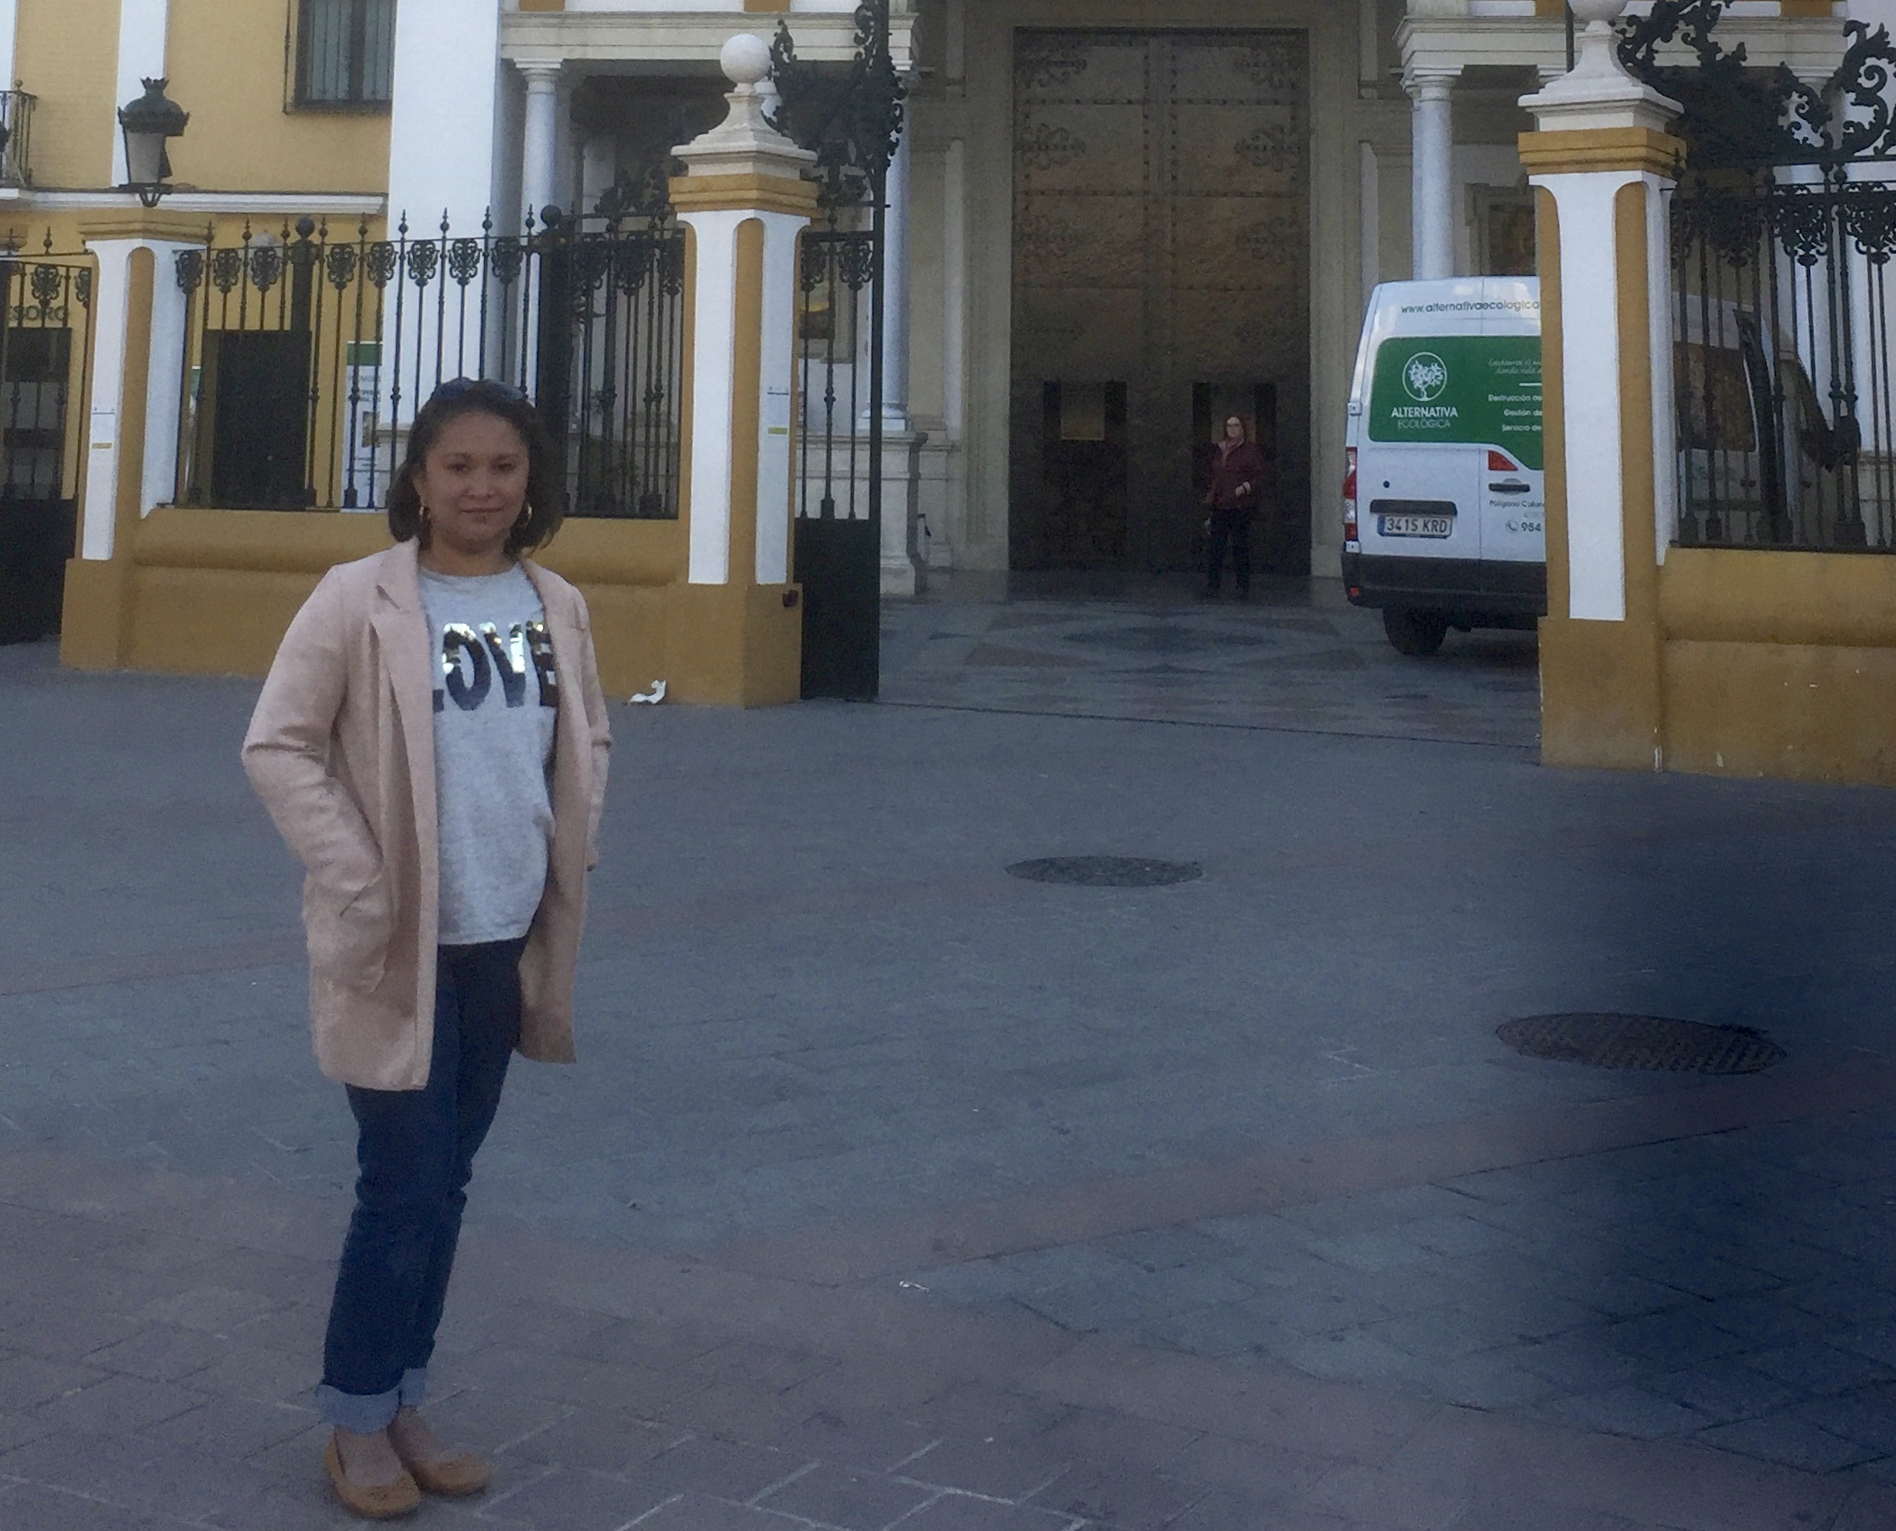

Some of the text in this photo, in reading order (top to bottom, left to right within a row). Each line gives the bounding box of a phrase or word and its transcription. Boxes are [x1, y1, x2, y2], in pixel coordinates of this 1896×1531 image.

[1391, 406, 1458, 417] ALTERNATIVA
[1387, 518, 1447, 533] 3415 KRD
[1521, 522, 1541, 532] 954
[433, 620, 559, 712] OVE
